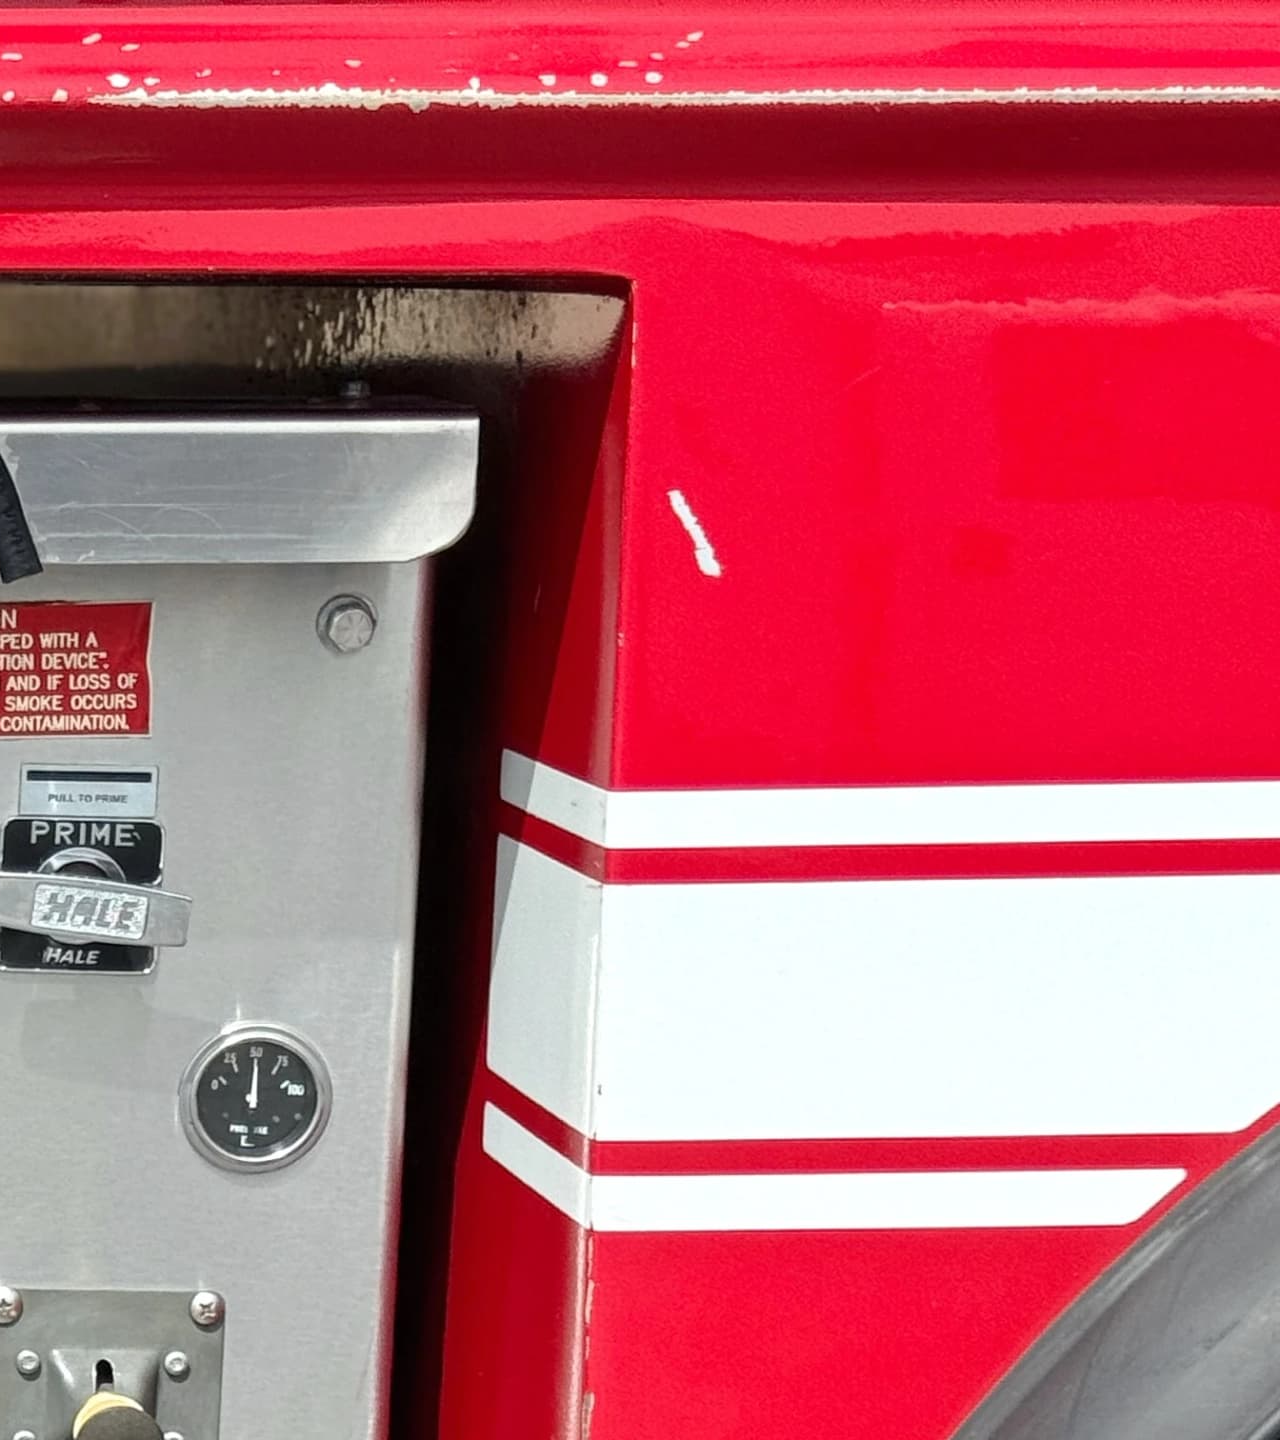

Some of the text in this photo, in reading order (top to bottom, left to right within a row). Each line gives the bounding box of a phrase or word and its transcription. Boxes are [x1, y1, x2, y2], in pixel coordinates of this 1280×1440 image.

[40, 632, 79, 649] WITH
[85, 632, 98, 648] A
[41, 652, 110, 670] DEVICE".
[5, 674, 41, 692] AND
[47, 674, 64, 691] IF
[69, 673, 110, 691] LOSS
[117, 673, 139, 689] OF
[4, 695, 64, 712] SMOKE
[70, 693, 137, 711] OCCURS
[0, 713, 130, 733] CONTAMINATION.
[47, 794, 129, 804] PULL TO PRIME
[30, 820, 135, 847] PRIME
[42, 892, 140, 931] HALE
[42, 947, 100, 965] HALE
[249, 1046, 264, 1058] 50
[210, 1079, 219, 1091] 0
[287, 1083, 305, 1096] 100
